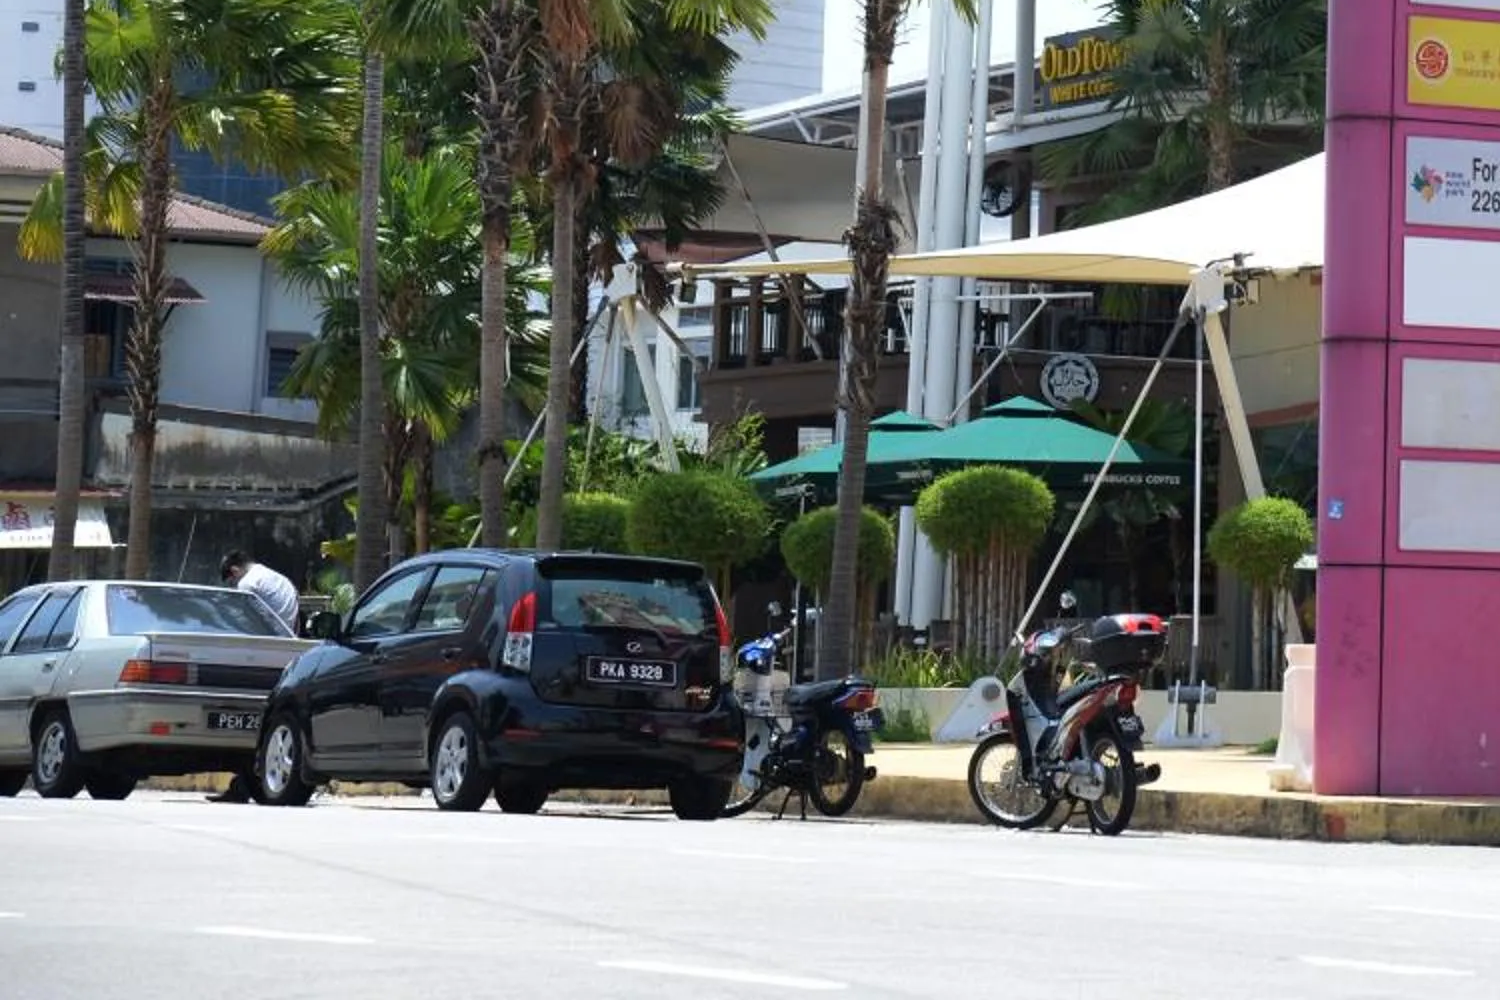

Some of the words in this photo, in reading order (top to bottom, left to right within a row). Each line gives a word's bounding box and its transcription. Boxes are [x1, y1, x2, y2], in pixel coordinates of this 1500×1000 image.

[1472, 157, 1499, 183] For
[1471, 189, 1500, 213] 226
[599, 661, 625, 678] PKA
